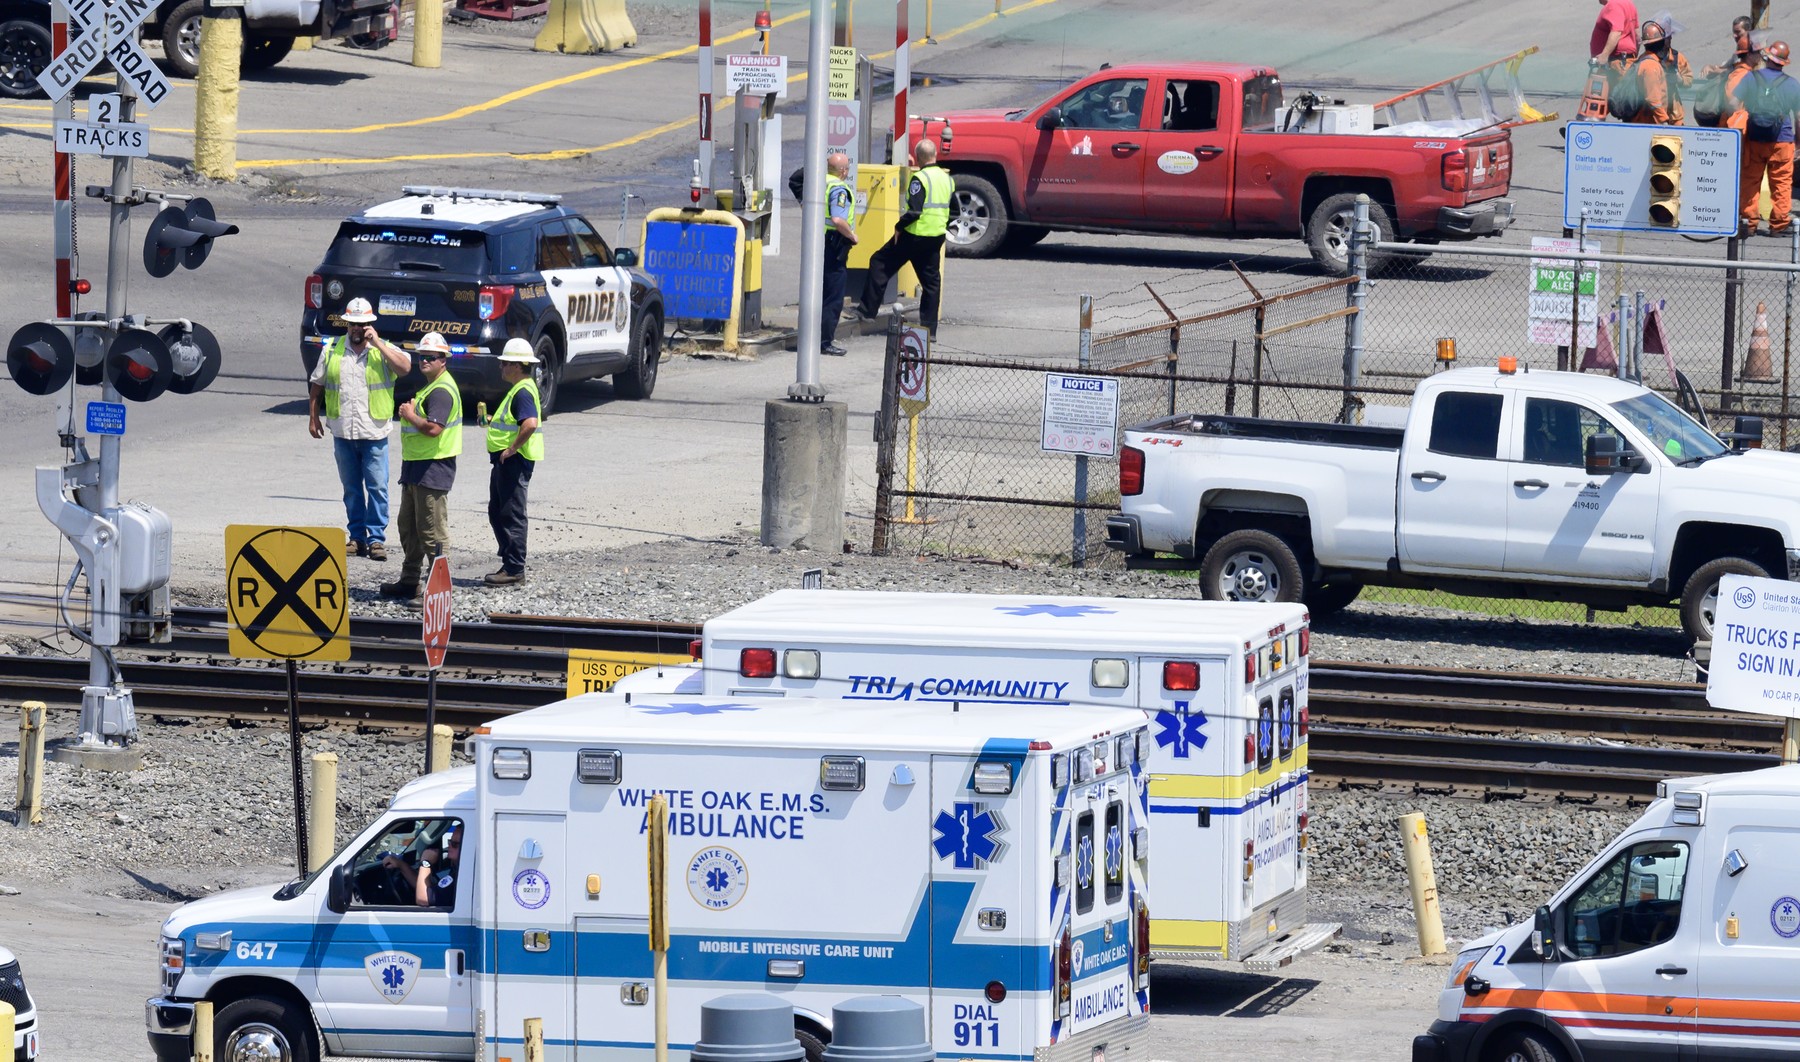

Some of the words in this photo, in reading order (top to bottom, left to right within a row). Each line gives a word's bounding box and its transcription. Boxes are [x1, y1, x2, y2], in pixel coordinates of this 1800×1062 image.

[731, 55, 778, 66] WARNING
[107, 39, 167, 104] ROAD
[97, 100, 112, 123] 2
[829, 116, 856, 135] TOP
[62, 127, 142, 148] TRACKS
[1578, 136, 1590, 145] USS
[1688, 150, 1708, 158] Injury
[1700, 158, 1714, 166] Day
[1574, 164, 1593, 172] United
[1580, 186, 1602, 194] Safety
[1692, 206, 1721, 214] Serious
[1696, 214, 1716, 222] Injury
[352, 233, 384, 242] JOIN
[388, 234, 462, 248] ACPD.COM
[678, 230, 706, 250] ALL
[648, 248, 730, 274] OCCUPANTS
[674, 273, 725, 294] VEHICLE
[1540, 269, 1556, 280] NO
[1557, 270, 1594, 282] ACTVE
[1551, 281, 1576, 292] ALER
[567, 290, 616, 326] POLICE
[408, 319, 471, 336] POLICE
[592, 328, 608, 338] COUNTY
[1064, 379, 1101, 391] NOTICE
[1572, 501, 1600, 510] 419400
[237, 576, 260, 608] R
[314, 578, 338, 610] R
[1736, 592, 1753, 604] USS
[1763, 592, 1789, 604] United
[425, 590, 451, 635] STOP
[1762, 602, 1790, 614] Clairton
[1726, 623, 1788, 649] TRUCKS
[582, 662, 608, 676] USS
[614, 664, 650, 677] CLA
[1737, 652, 1775, 675] SIGN
[1778, 657, 1794, 678] IN
[848, 674, 897, 694] TRI
[919, 677, 1070, 699] COMMUNITY
[1762, 688, 1774, 699] NO
[1776, 690, 1792, 702] CAR
[618, 788, 694, 809] WHTE
[701, 790, 753, 811] OAK
[760, 792, 830, 813] E.M.S.
[1256, 807, 1292, 844] AMBULANCE
[1254, 834, 1295, 870] TRI-COMMUNITY
[690, 850, 722, 872] WHITE
[724, 852, 744, 875] OAK
[706, 898, 729, 908] EMS
[236, 941, 278, 960] 647
[698, 940, 750, 954] MOBILE
[752, 942, 821, 956] INTENSIVE
[824, 944, 860, 958] CARE
[863, 946, 894, 960] UNIT
[1084, 952, 1100, 971] WHITE
[1100, 947, 1112, 965] OAK
[1112, 943, 1128, 962] E.M.S.
[1492, 944, 1507, 966] 2
[370, 954, 397, 968] WHITE
[398, 955, 416, 969] OAK
[383, 988, 404, 996] E.M.S.
[954, 1004, 999, 1021] DIAL
[1074, 983, 1124, 1024] AMBULANCE
[954, 1021, 999, 1047] 911
